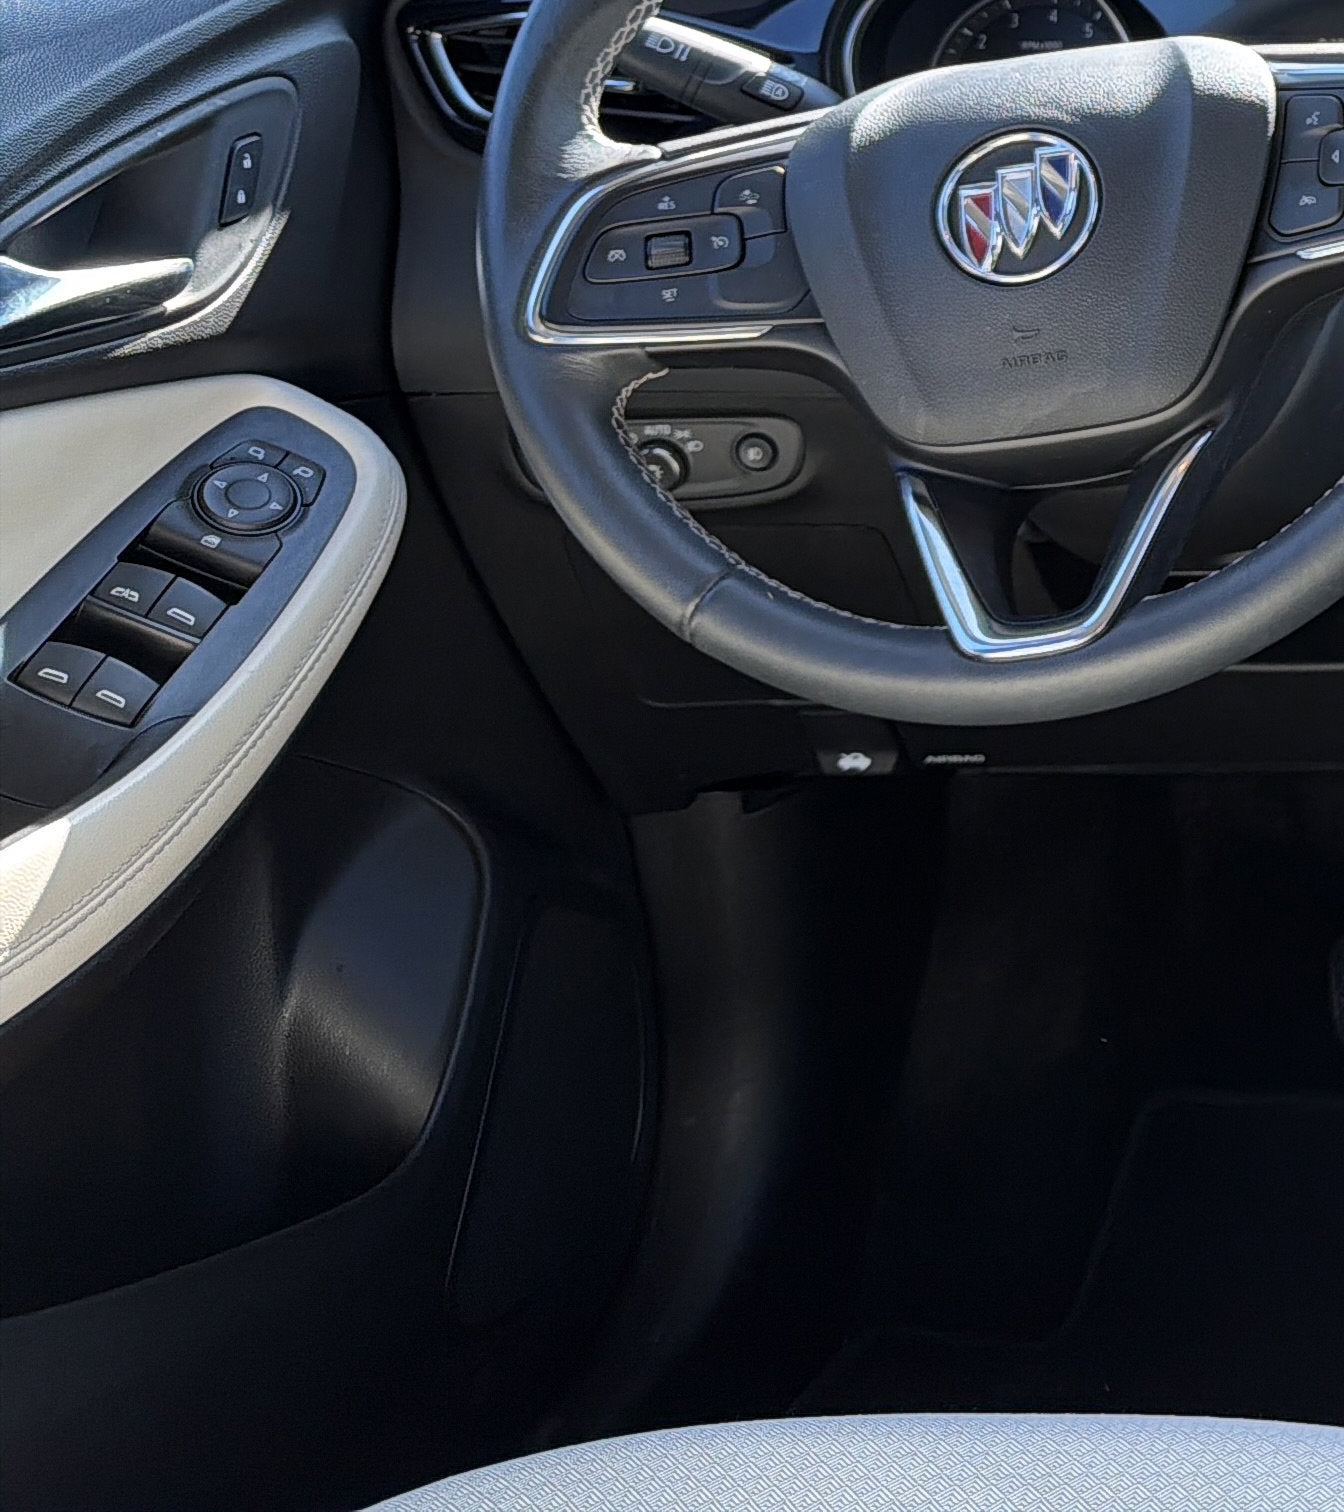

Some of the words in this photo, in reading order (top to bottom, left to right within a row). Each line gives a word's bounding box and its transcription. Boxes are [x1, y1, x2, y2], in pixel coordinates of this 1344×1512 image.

[1011, 12, 1019, 29] 3
[979, 34, 987, 50] 2
[1001, 349, 1068, 368] AIRBAG
